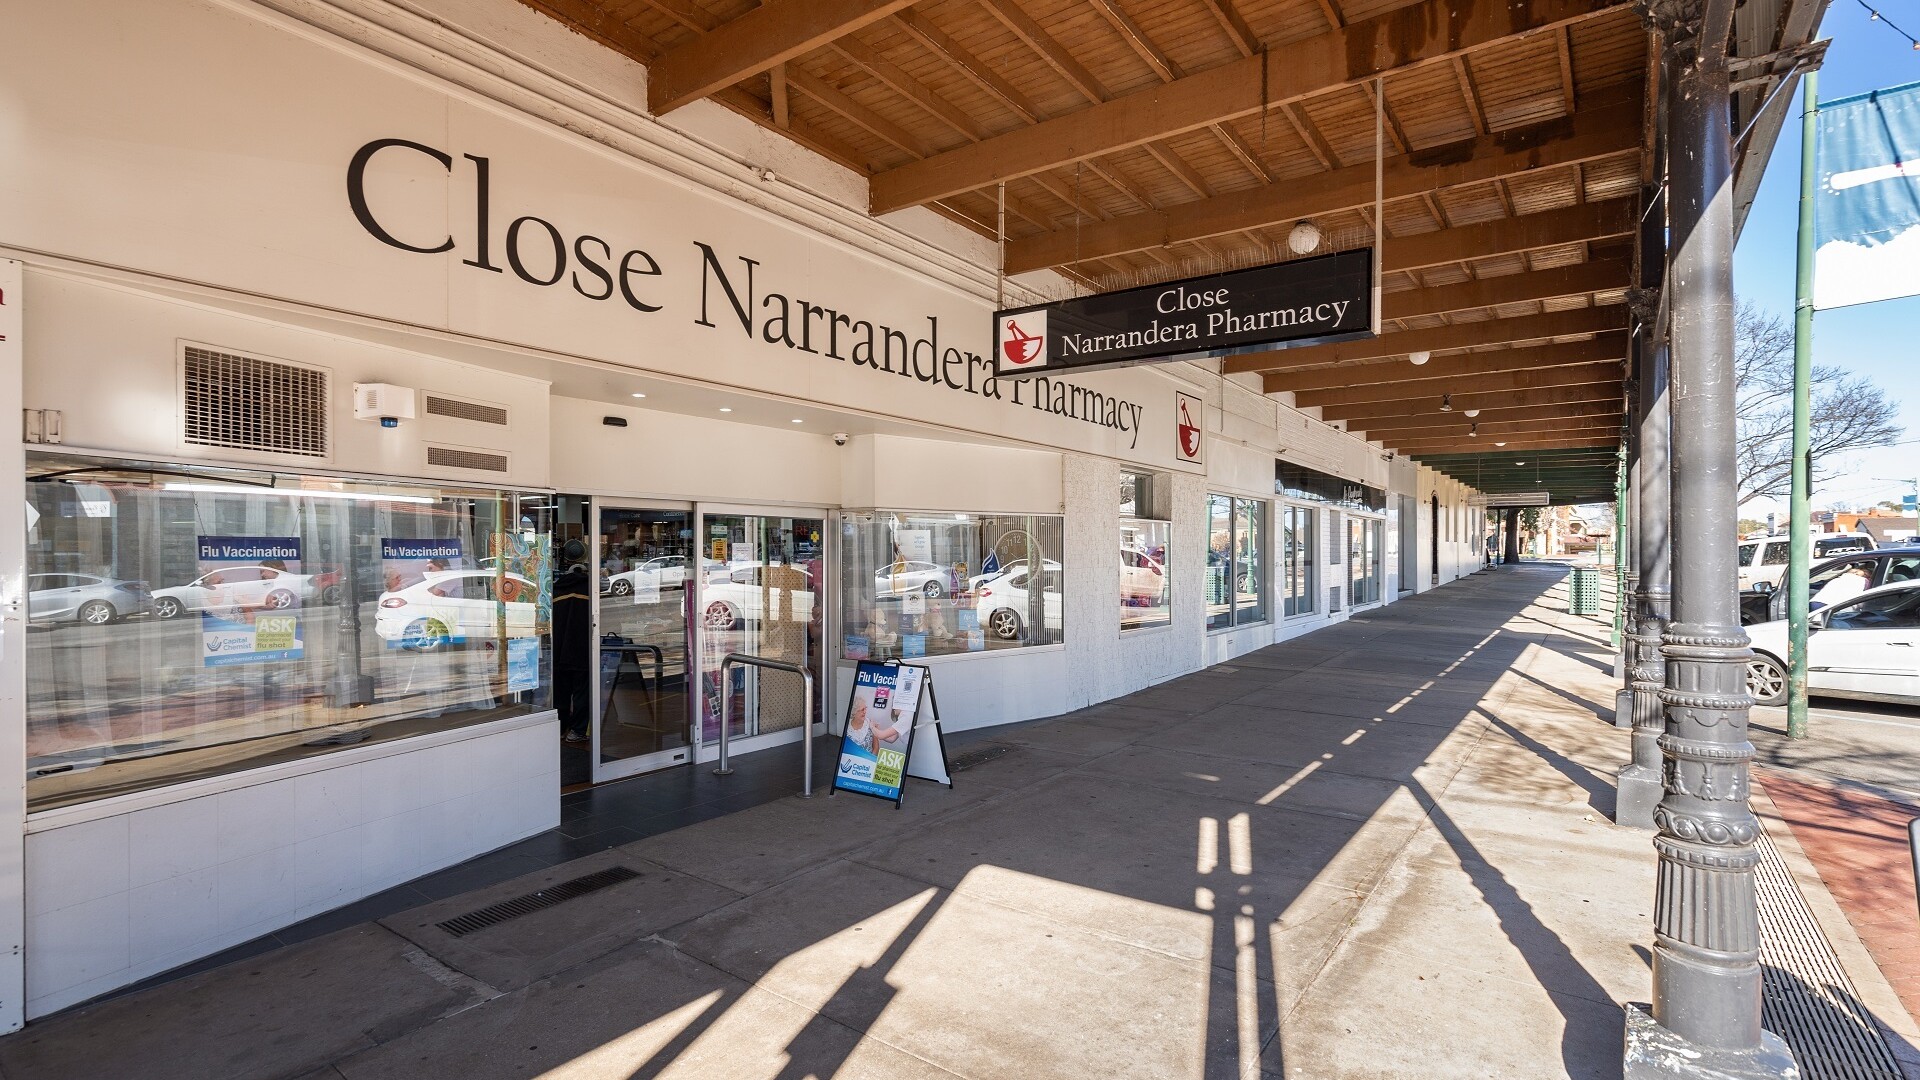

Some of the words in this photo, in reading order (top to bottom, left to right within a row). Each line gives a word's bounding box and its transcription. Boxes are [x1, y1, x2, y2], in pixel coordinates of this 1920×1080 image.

[346, 138, 664, 313] Close
[693, 240, 1002, 401] Narrandera
[1156, 286, 1230, 315] Close
[1061, 319, 1199, 357] Narrandera
[1206, 299, 1350, 337] Pharmacy
[1006, 538, 1013, 547] 11
[1013, 535, 1021, 544] 12
[201, 545, 219, 558] Flu
[222, 545, 298, 558] Vaccination
[384, 546, 396, 557] Flu
[399, 546, 459, 557] Vaccination
[258, 618, 293, 633] ASK
[223, 637, 248, 646] Capital
[223, 643, 252, 651] Chemist
[214, 654, 276, 665] capitalchemist.com.au
[858, 670, 871, 683] Flu
[877, 751, 904, 770] ASK
[852, 763, 871, 772] Capital
[851, 769, 872, 779] Chemist
[881, 776, 894, 785] shot
